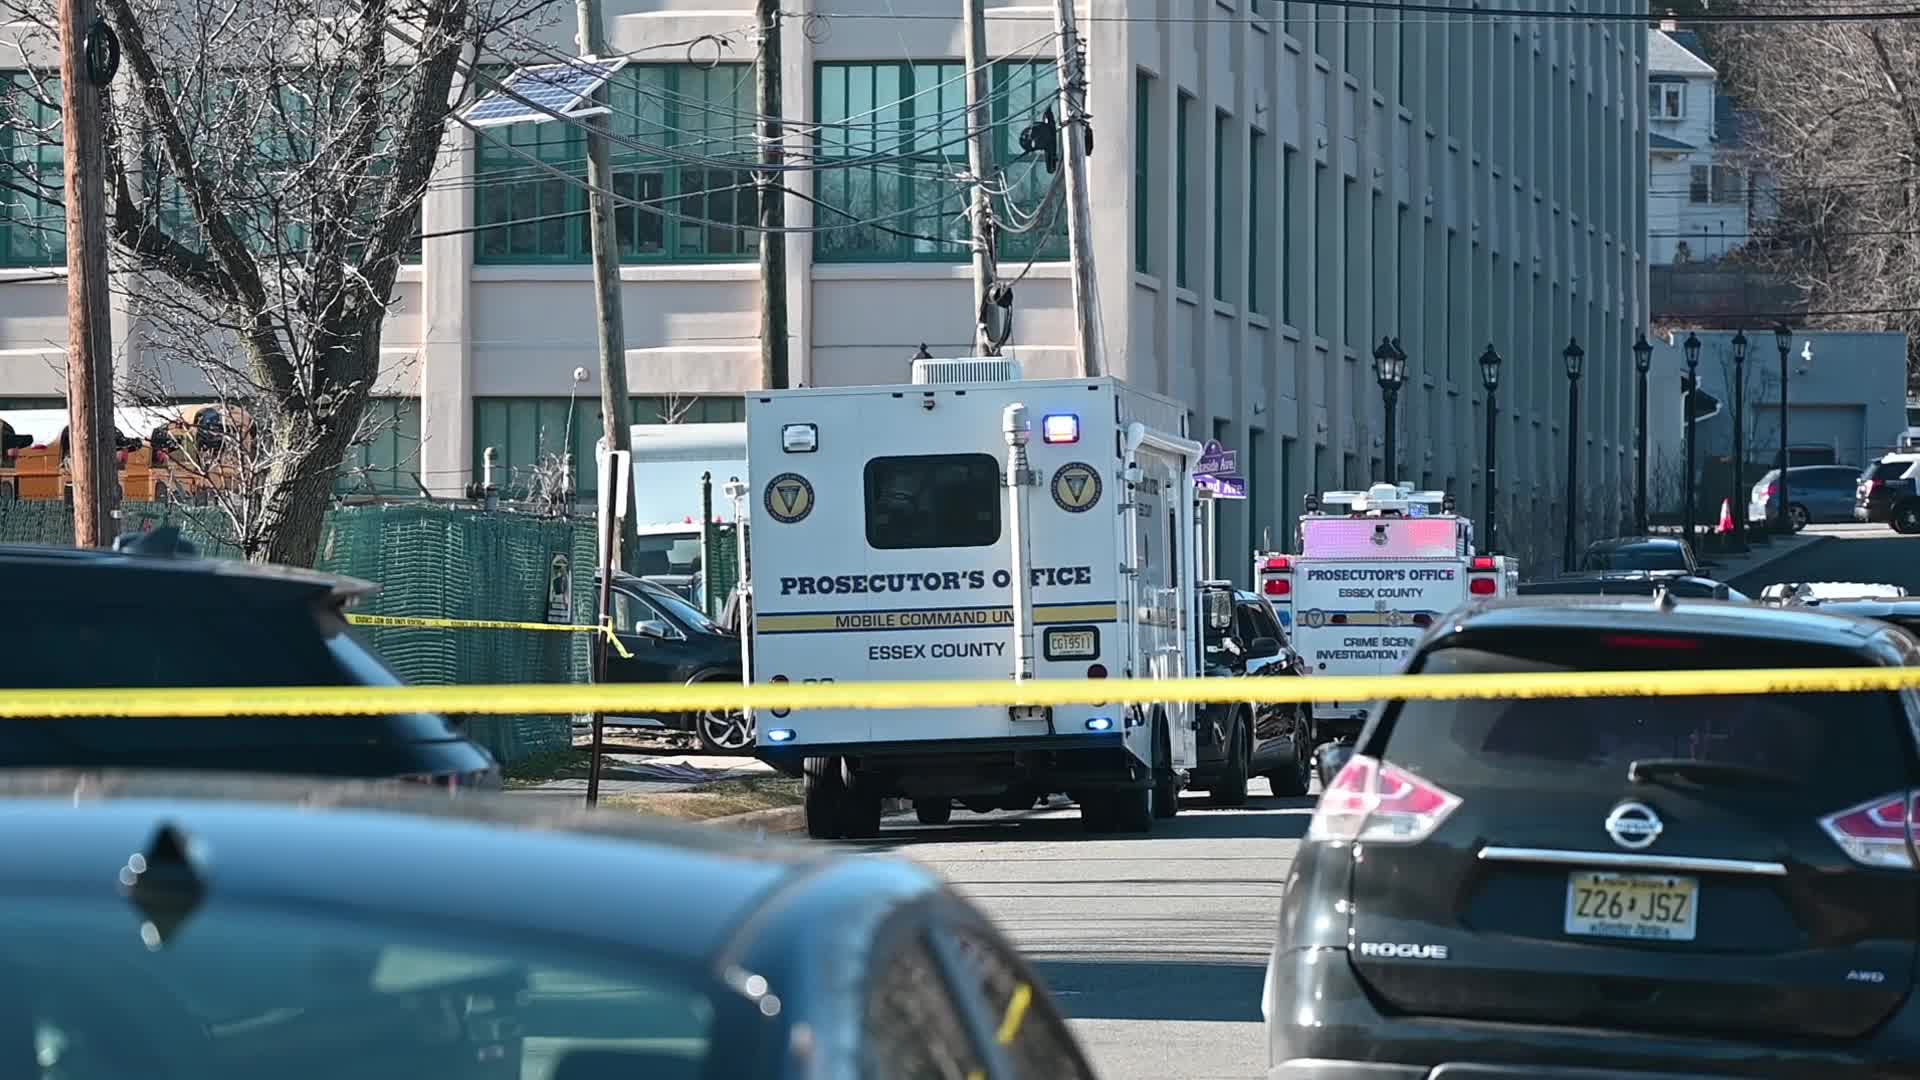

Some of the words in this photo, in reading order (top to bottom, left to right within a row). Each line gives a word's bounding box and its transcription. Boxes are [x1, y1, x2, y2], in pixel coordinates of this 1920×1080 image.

[780, 570, 985, 596] PROSECUTOR'S
[992, 566, 1092, 588] OFICE
[1307, 569, 1405, 581] PROSECUTOR'S
[1409, 569, 1455, 581] OFFICE
[1338, 588, 1375, 598] ESSEX
[1377, 588, 1424, 598] COUNTY
[836, 614, 895, 628] MOBILE
[900, 612, 987, 626] COMMAND
[992, 610, 1015, 624] UN
[1343, 637, 1378, 648] CRIME
[1382, 637, 1416, 648] SCEN
[868, 644, 926, 660] ESSEX
[931, 642, 1006, 658] COUNTY
[1316, 650, 1398, 660] INVESTIGATION
[1361, 942, 1448, 959] ROGUE
